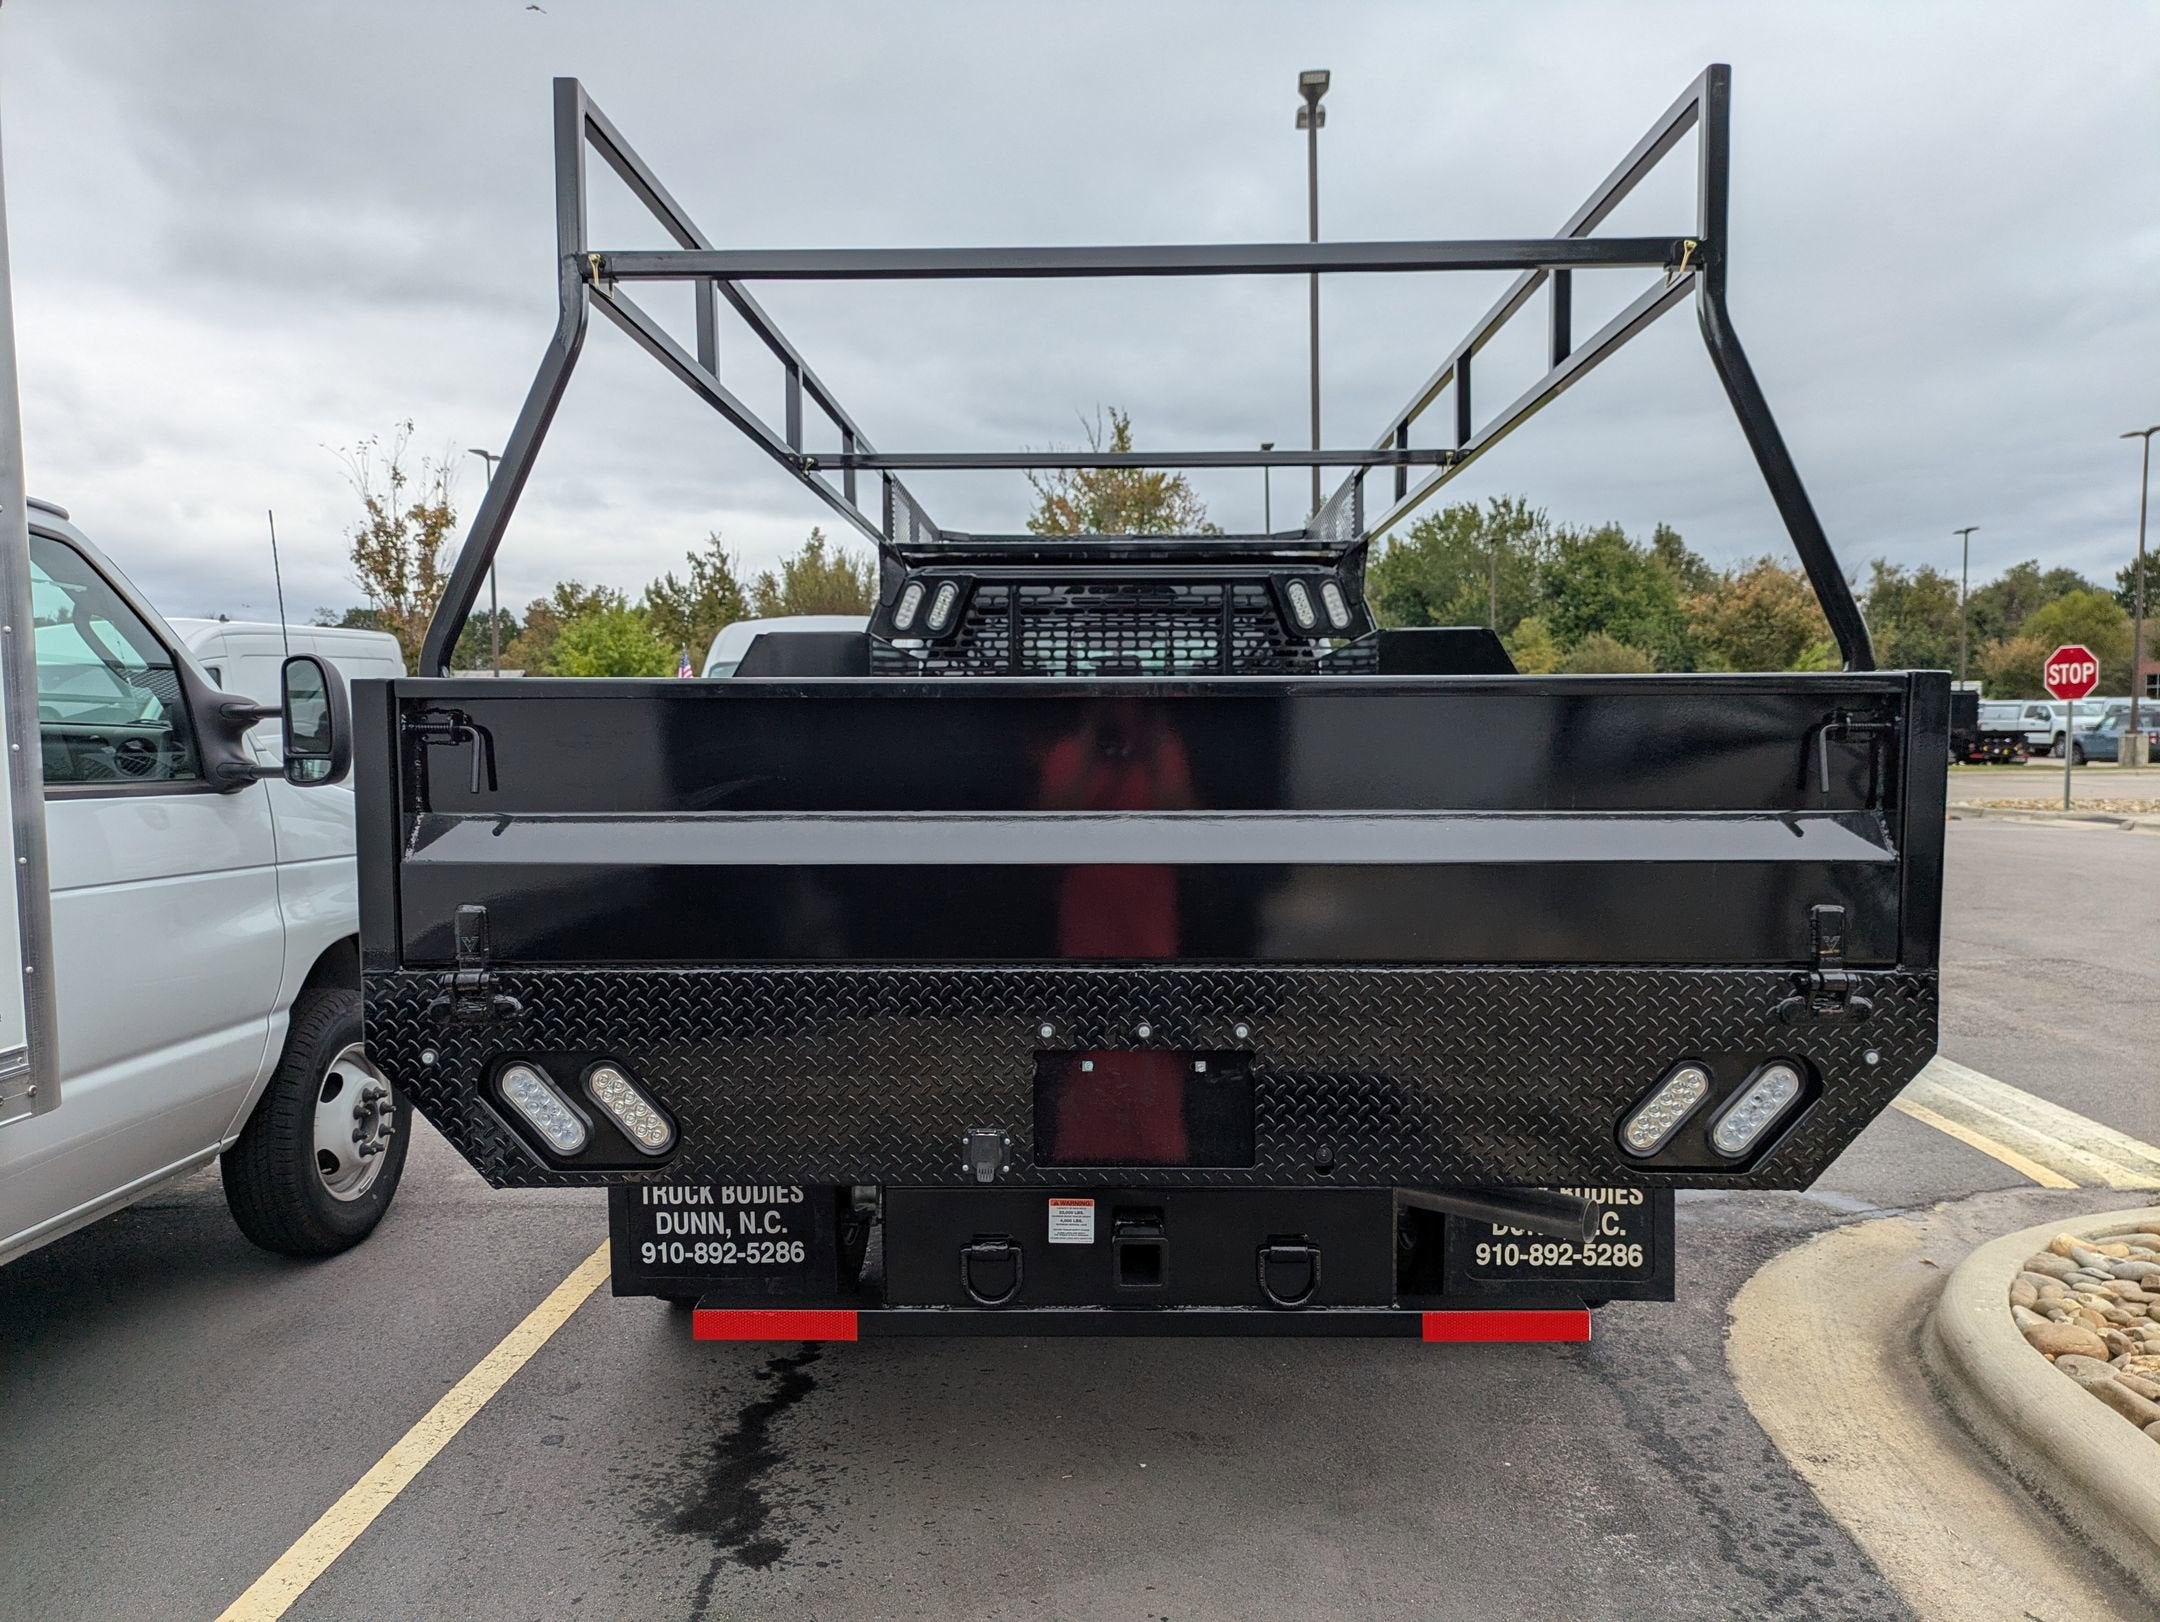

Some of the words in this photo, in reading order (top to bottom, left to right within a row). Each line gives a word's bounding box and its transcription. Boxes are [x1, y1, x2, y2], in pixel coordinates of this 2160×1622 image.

[2048, 662, 2094, 685] STOP
[642, 1186, 715, 1205] TRUCK
[721, 1185, 804, 1204] BODIES
[656, 1211, 732, 1239] DUNN,
[739, 1210, 788, 1234] N.C.
[1595, 1211, 1626, 1236] .C.
[641, 1241, 805, 1264] 910-892-5286
[1475, 1243, 1644, 1267] 910-892-5286
